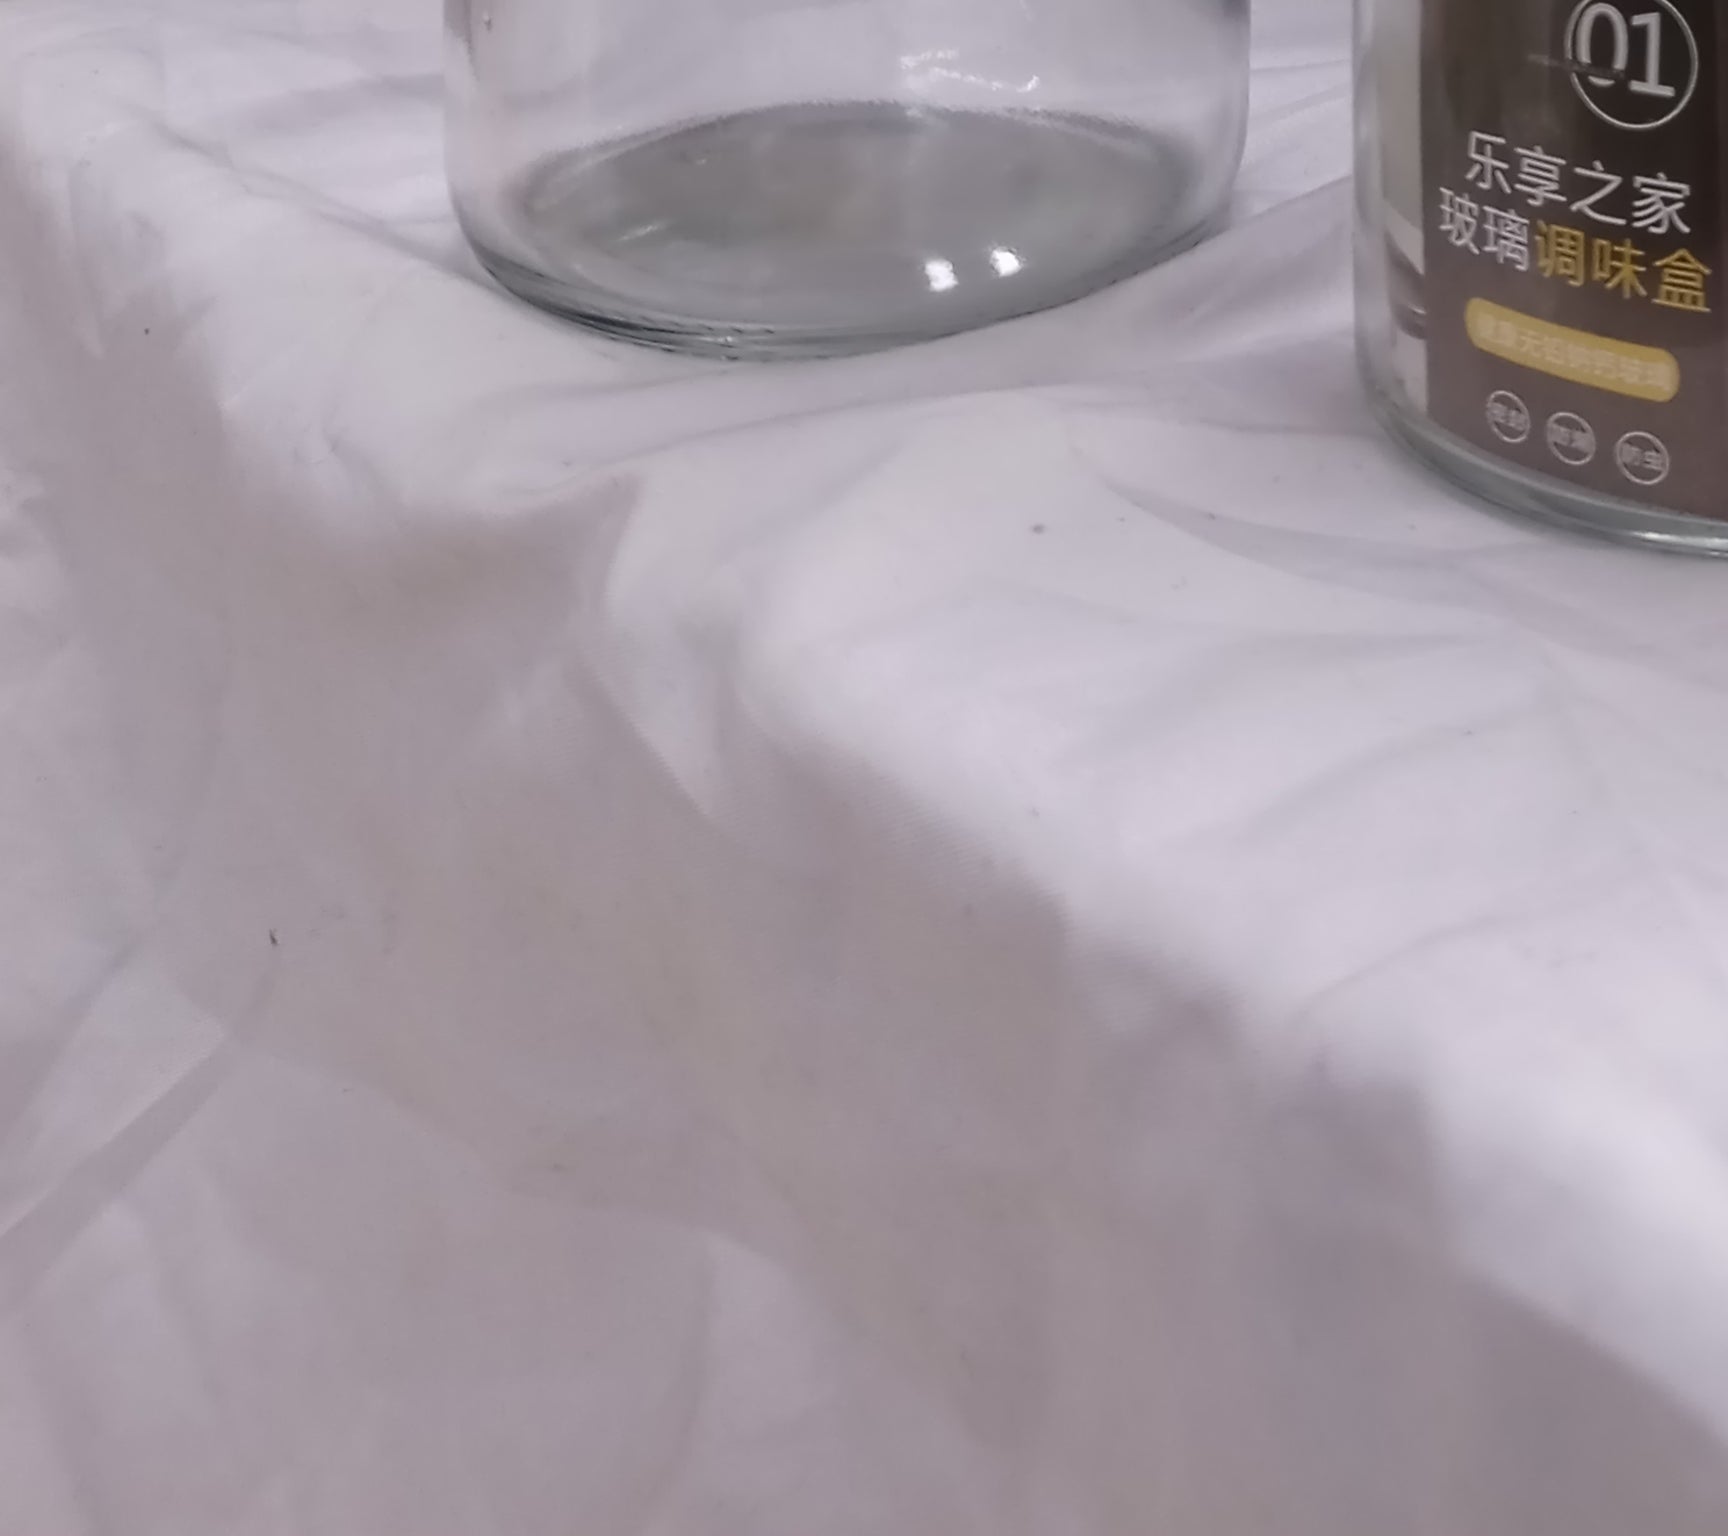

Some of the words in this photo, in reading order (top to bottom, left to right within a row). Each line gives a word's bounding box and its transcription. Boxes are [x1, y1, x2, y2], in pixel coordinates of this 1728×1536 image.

[1576, 2, 1676, 97] 01
[1466, 131, 1691, 234] 乐享之家
[1439, 186, 1712, 312] 玻璃调味盒
